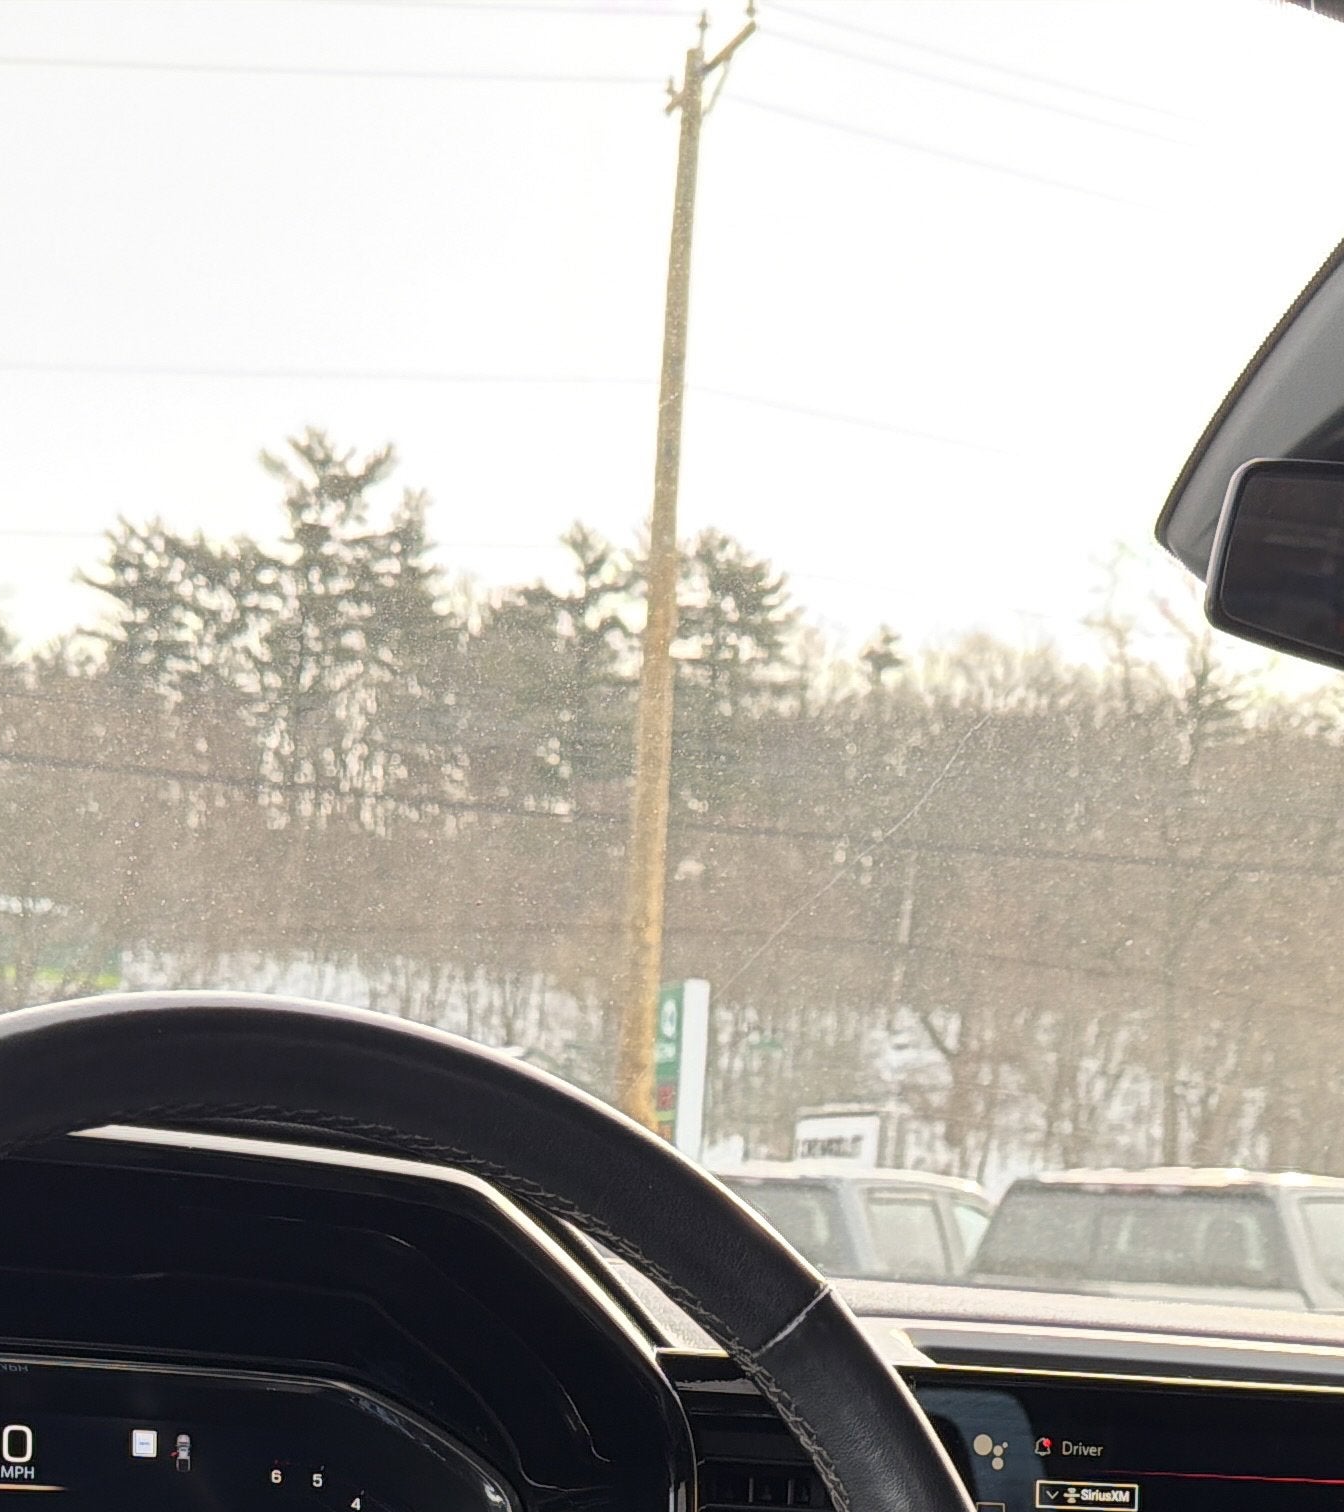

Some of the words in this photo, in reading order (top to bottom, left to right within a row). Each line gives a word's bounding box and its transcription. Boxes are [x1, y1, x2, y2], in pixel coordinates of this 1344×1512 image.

[2, 1424, 33, 1463] 0
[1062, 1440, 1103, 1457] Driver
[0, 1465, 35, 1479] MPH
[271, 1469, 282, 1484] 6
[312, 1473, 323, 1488] 5
[1080, 1488, 1130, 1504] SiriusXM
[350, 1498, 361, 1511] 4
